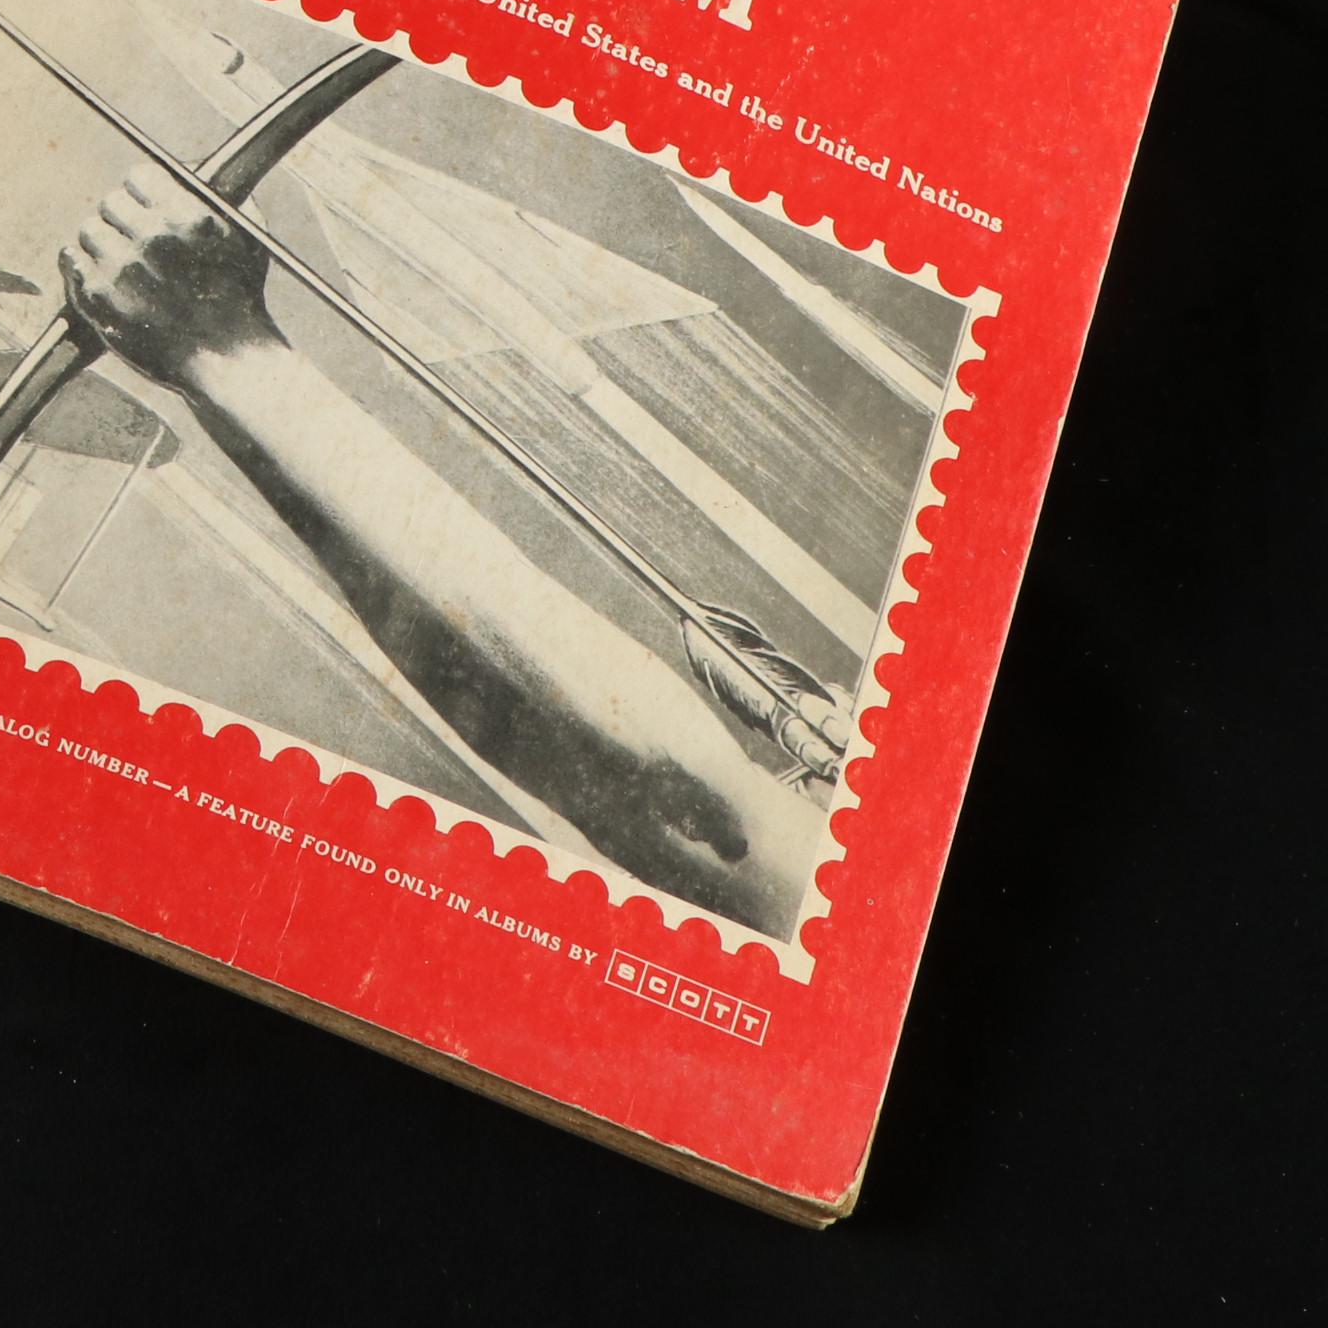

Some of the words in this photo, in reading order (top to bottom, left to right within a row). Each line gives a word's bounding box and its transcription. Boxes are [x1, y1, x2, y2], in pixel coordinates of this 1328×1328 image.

[581, 22, 670, 79] States
[676, 70, 733, 109] and
[739, 94, 785, 132] the
[794, 115, 891, 182] United
[897, 166, 1004, 234] Nations
[196, 790, 296, 844] FEATURE
[300, 833, 378, 875] FOUND
[384, 868, 444, 903] ONLY
[446, 892, 472, 914] IN
[474, 905, 563, 953] ALBUMS
[567, 943, 599, 967] BY
[616, 961, 762, 1034] SCOTT
